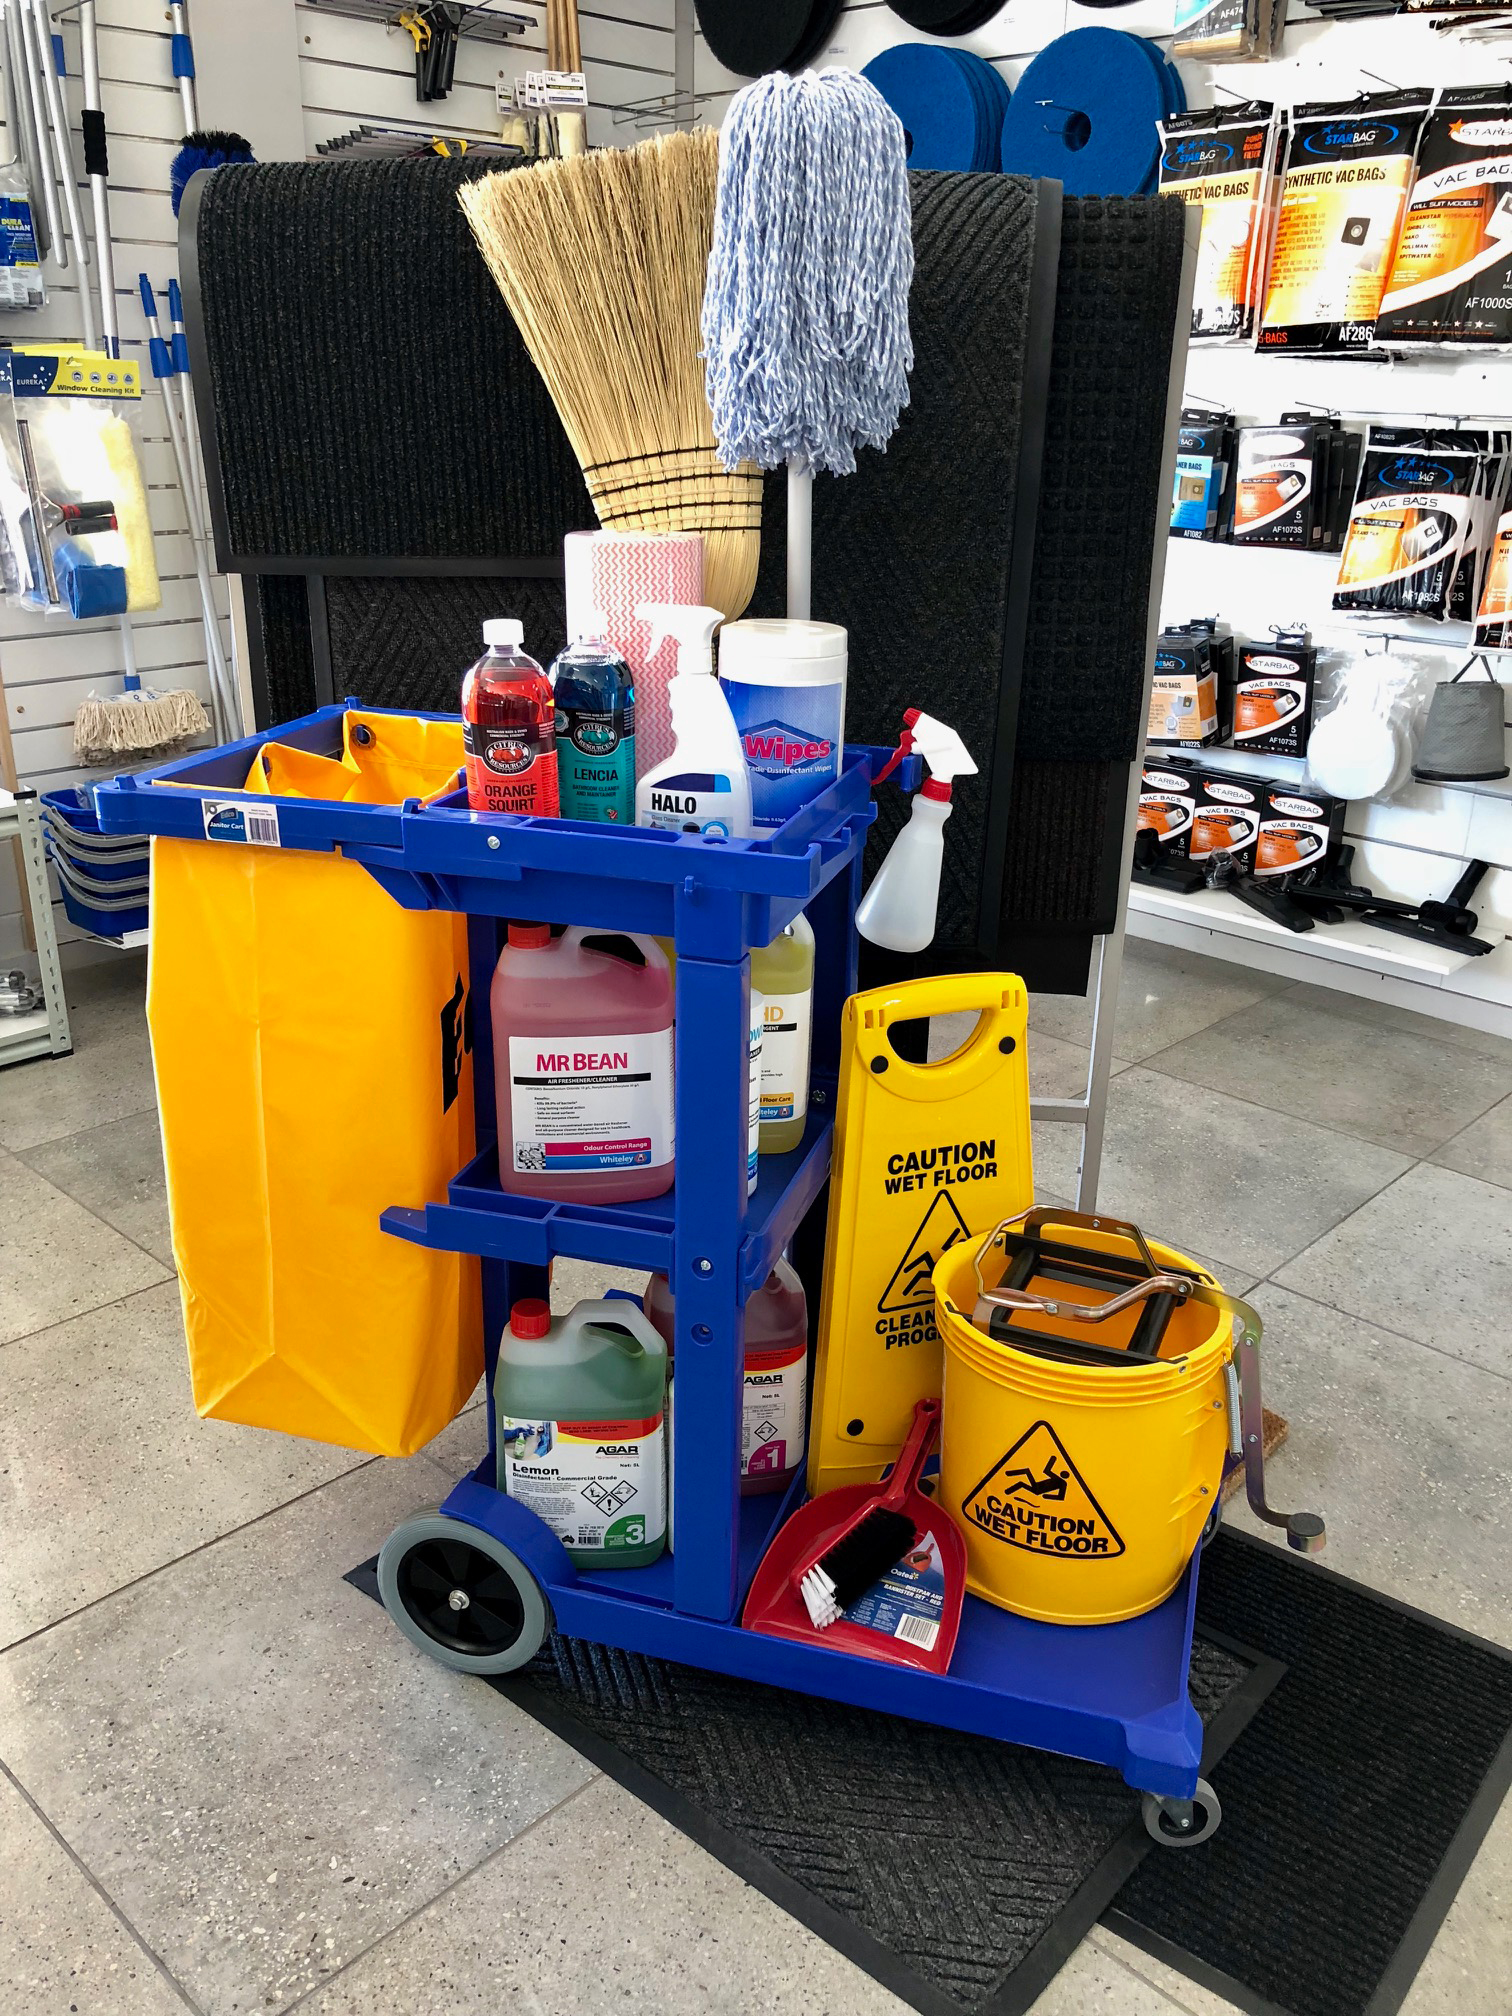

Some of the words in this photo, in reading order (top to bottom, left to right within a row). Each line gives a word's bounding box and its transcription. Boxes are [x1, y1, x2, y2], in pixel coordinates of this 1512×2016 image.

[1325, 130, 1377, 146] STARBAG
[1178, 149, 1216, 163] STARBAG
[1285, 171, 1333, 190] SYNTHETIC
[1335, 169, 1355, 184] VAC
[1356, 167, 1386, 182] BAGS
[1433, 170, 1467, 188] VAC
[1475, 163, 1512, 178] BAG
[1204, 185, 1222, 199] VAC
[1223, 181, 1249, 197] BAGS
[1413, 202, 1427, 210] WILL
[1465, 296, 1512, 310] AF1000S
[1258, 331, 1288, 344] 5-BAGS
[1339, 325, 1375, 341] AF286
[57, 384, 88, 392] Window
[90, 385, 124, 395] Cleaning
[1188, 462, 1202, 470] BAGS
[1395, 470, 1436, 482] STARBAG
[1370, 498, 1397, 511] VAC
[1402, 496, 1439, 508] BAGS
[1296, 511, 1302, 519] 5
[1183, 529, 1202, 538] AF1082
[1272, 526, 1303, 534] AF1073S
[1437, 571, 1442, 582] 5
[1457, 571, 1464, 581] 5
[1251, 660, 1296, 671] STARBAG
[582, 723, 610, 733] CITRUS
[1291, 725, 1296, 734] 5
[493, 741, 525, 750] CITRUS
[578, 739, 614, 751] RESOURCES
[1269, 736, 1297, 746] AF1073S
[490, 758, 528, 769] RESOURCES
[767, 766, 813, 775] Disinfectant
[815, 764, 832, 773] Wipes
[574, 767, 619, 781] LENCIA
[1146, 775, 1186, 788] STARBAG
[484, 783, 538, 798] ORANGE
[1210, 787, 1251, 801] STARBAG
[488, 798, 535, 812] SQUIRT
[651, 793, 697, 814] HALO
[1275, 801, 1319, 814] STARBAG
[221, 811, 235, 819] Edco
[1223, 808, 1246, 816] BAGS
[210, 821, 230, 829] Janitor
[1290, 822, 1314, 831] BAGS
[1169, 848, 1185, 857] 073S
[536, 1054, 570, 1072] MR
[573, 1052, 628, 1071] BEAN
[558, 1076, 618, 1084] FRESHENER/CLEANER
[628, 1142, 648, 1150] Range
[600, 1154, 634, 1164] Whiteley
[887, 1139, 996, 1175] CAUTION
[885, 1173, 927, 1195] WET
[933, 1162, 997, 1187] FLOOR
[875, 1309, 935, 1335] CLEAN
[886, 1328, 942, 1350] PROG
[744, 1375, 783, 1385] AGAR
[596, 1446, 639, 1455] AGAR
[767, 1449, 779, 1468] 1
[512, 1463, 559, 1475] Lemon
[512, 1472, 551, 1481] Disinfectant
[986, 1495, 1095, 1535] CAUTION
[975, 1503, 1020, 1539] WET
[1026, 1531, 1108, 1553] FLOOR
[625, 1524, 644, 1545] 3
[890, 1568, 914, 1580] Oates
[905, 1585, 931, 1597] DUSTPAN
[931, 1593, 943, 1601] AND
[914, 1593, 926, 1601] SET
